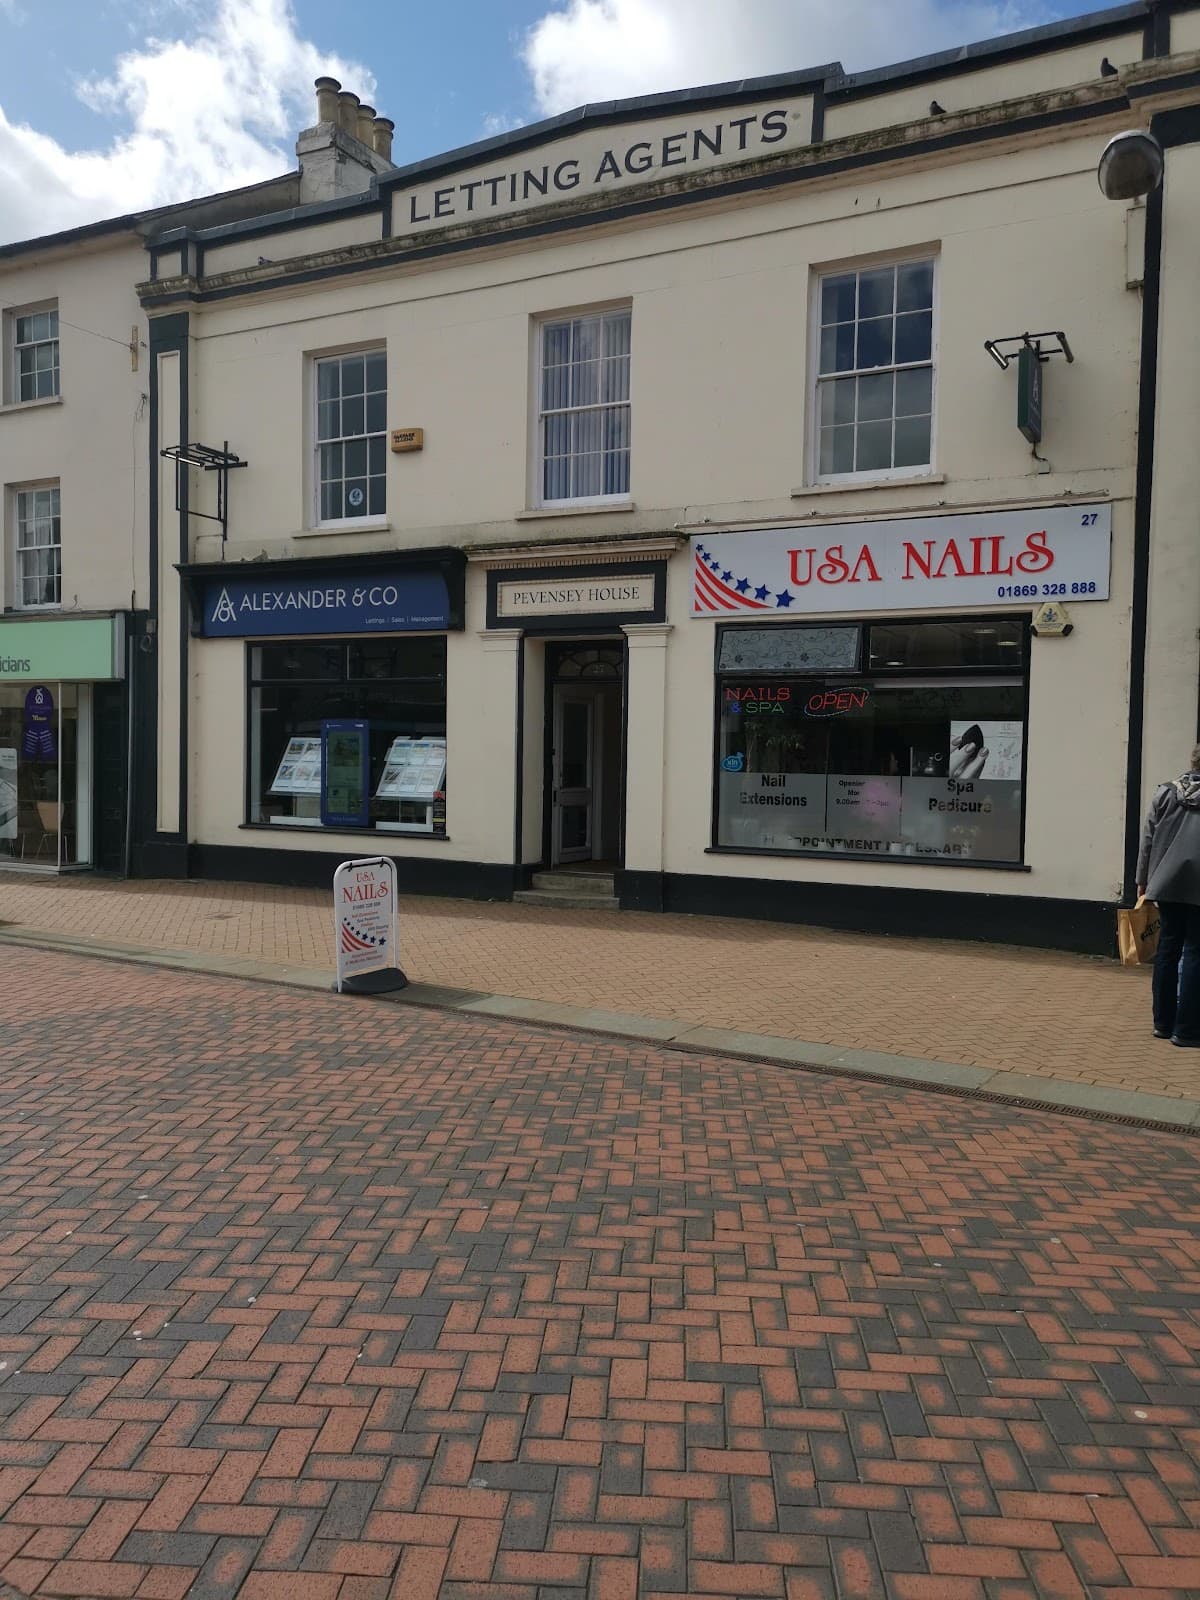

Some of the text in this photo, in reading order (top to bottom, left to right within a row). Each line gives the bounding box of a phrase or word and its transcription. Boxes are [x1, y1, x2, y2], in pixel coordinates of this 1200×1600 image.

[410, 110, 789, 223] LETTING AGENTS
[1081, 513, 1099, 526] 27
[787, 530, 1055, 586] USA NAILS
[513, 586, 640, 605] PEVENSEY HOUSE
[997, 581, 1097, 598] 01869 328 888
[240, 588, 347, 612] ALEXANDER
[369, 586, 398, 606] CO
[411, 615, 444, 624] Management
[725, 687, 792, 701] NAILS
[808, 692, 866, 711] OPEN
[745, 702, 785, 714] SPA
[761, 774, 786, 787] Nail
[947, 778, 974, 796] Spa
[739, 792, 807, 806] Extensions
[928, 797, 992, 813] Pedicure
[356, 871, 375, 883] USA
[342, 881, 389, 903] NAILS
